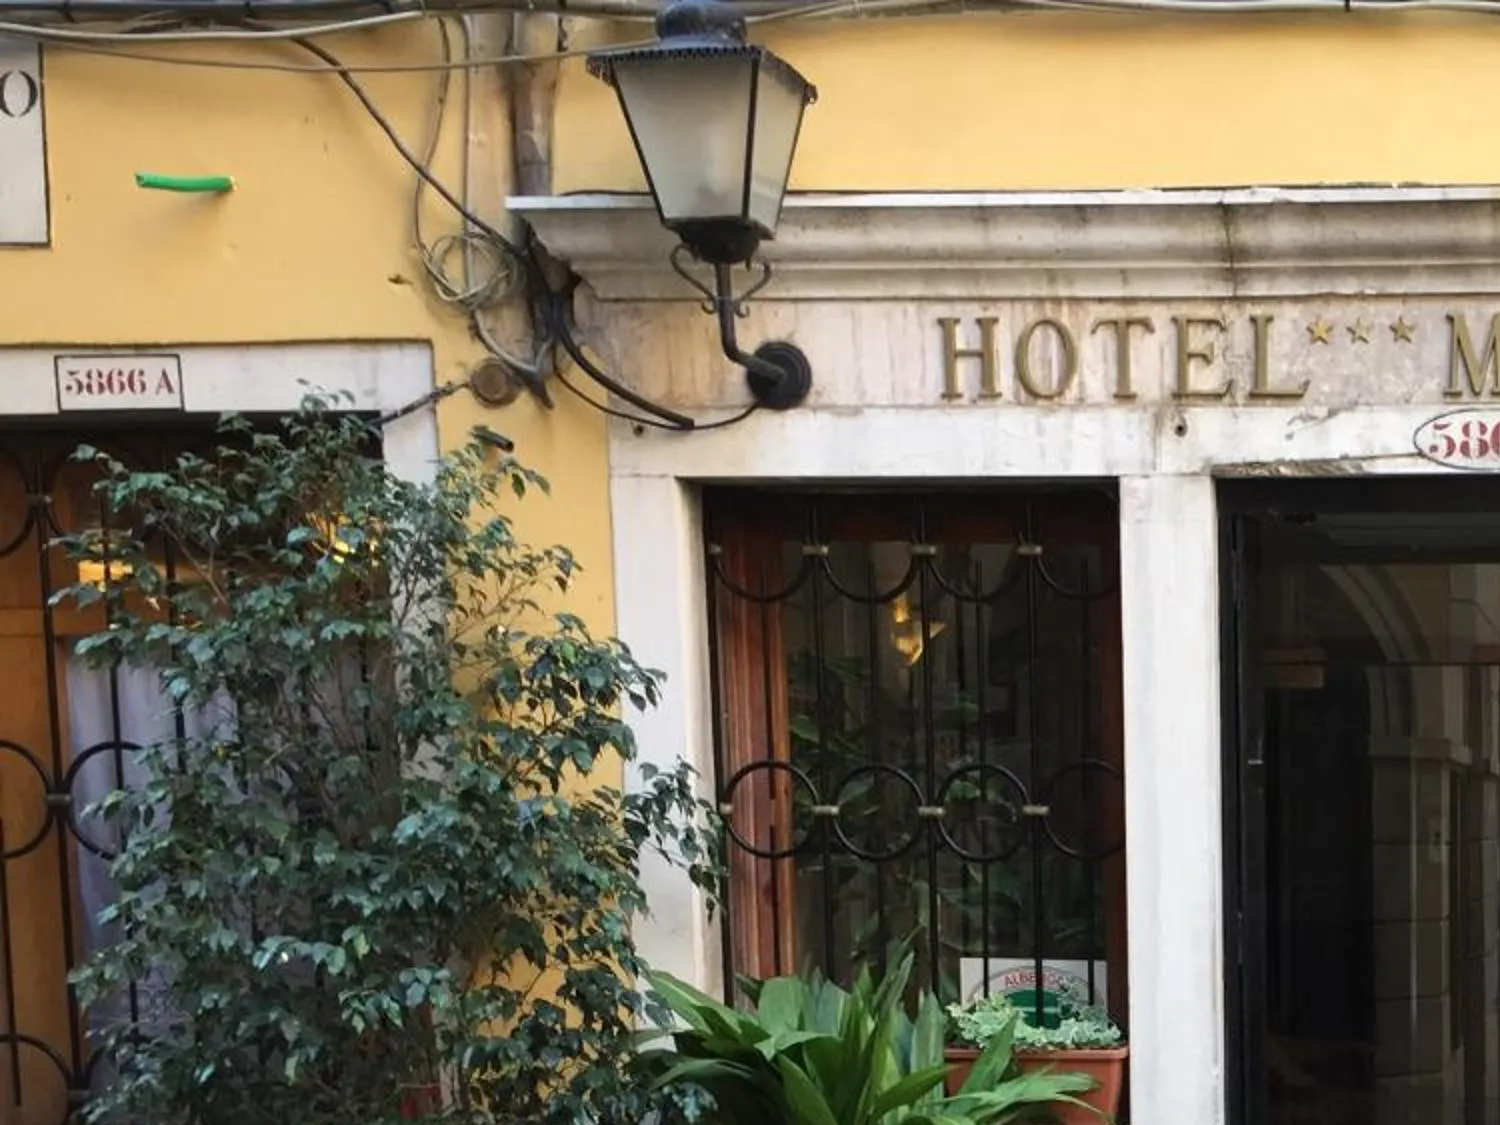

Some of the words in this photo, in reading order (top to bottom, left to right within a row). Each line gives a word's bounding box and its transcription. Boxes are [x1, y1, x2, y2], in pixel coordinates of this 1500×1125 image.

[65, 368, 148, 396] 5866
[154, 368, 175, 396] A
[936, 313, 1311, 400] HOTEL
